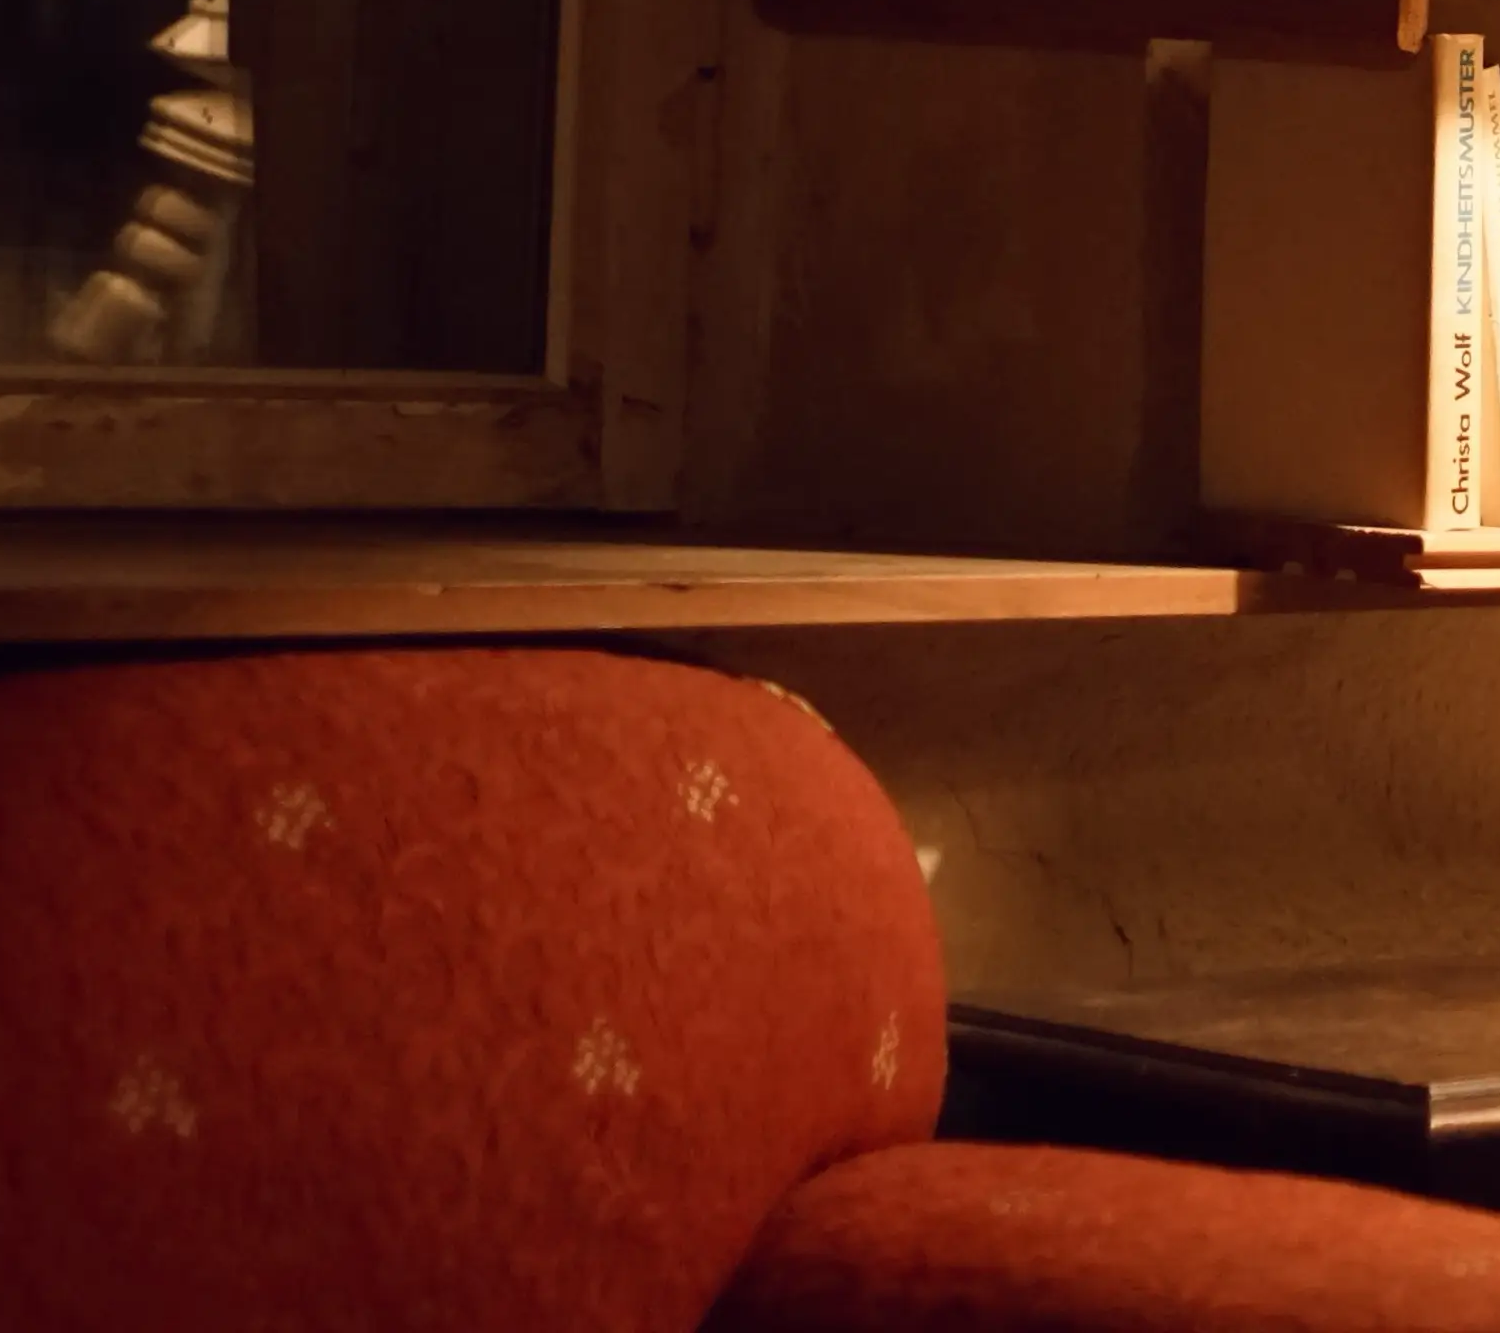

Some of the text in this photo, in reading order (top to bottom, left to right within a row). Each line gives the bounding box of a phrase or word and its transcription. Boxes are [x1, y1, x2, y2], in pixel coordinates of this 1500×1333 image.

[1454, 48, 1476, 316] KINDHEITSMUSTER
[1450, 331, 1474, 516] Christa Wolf
